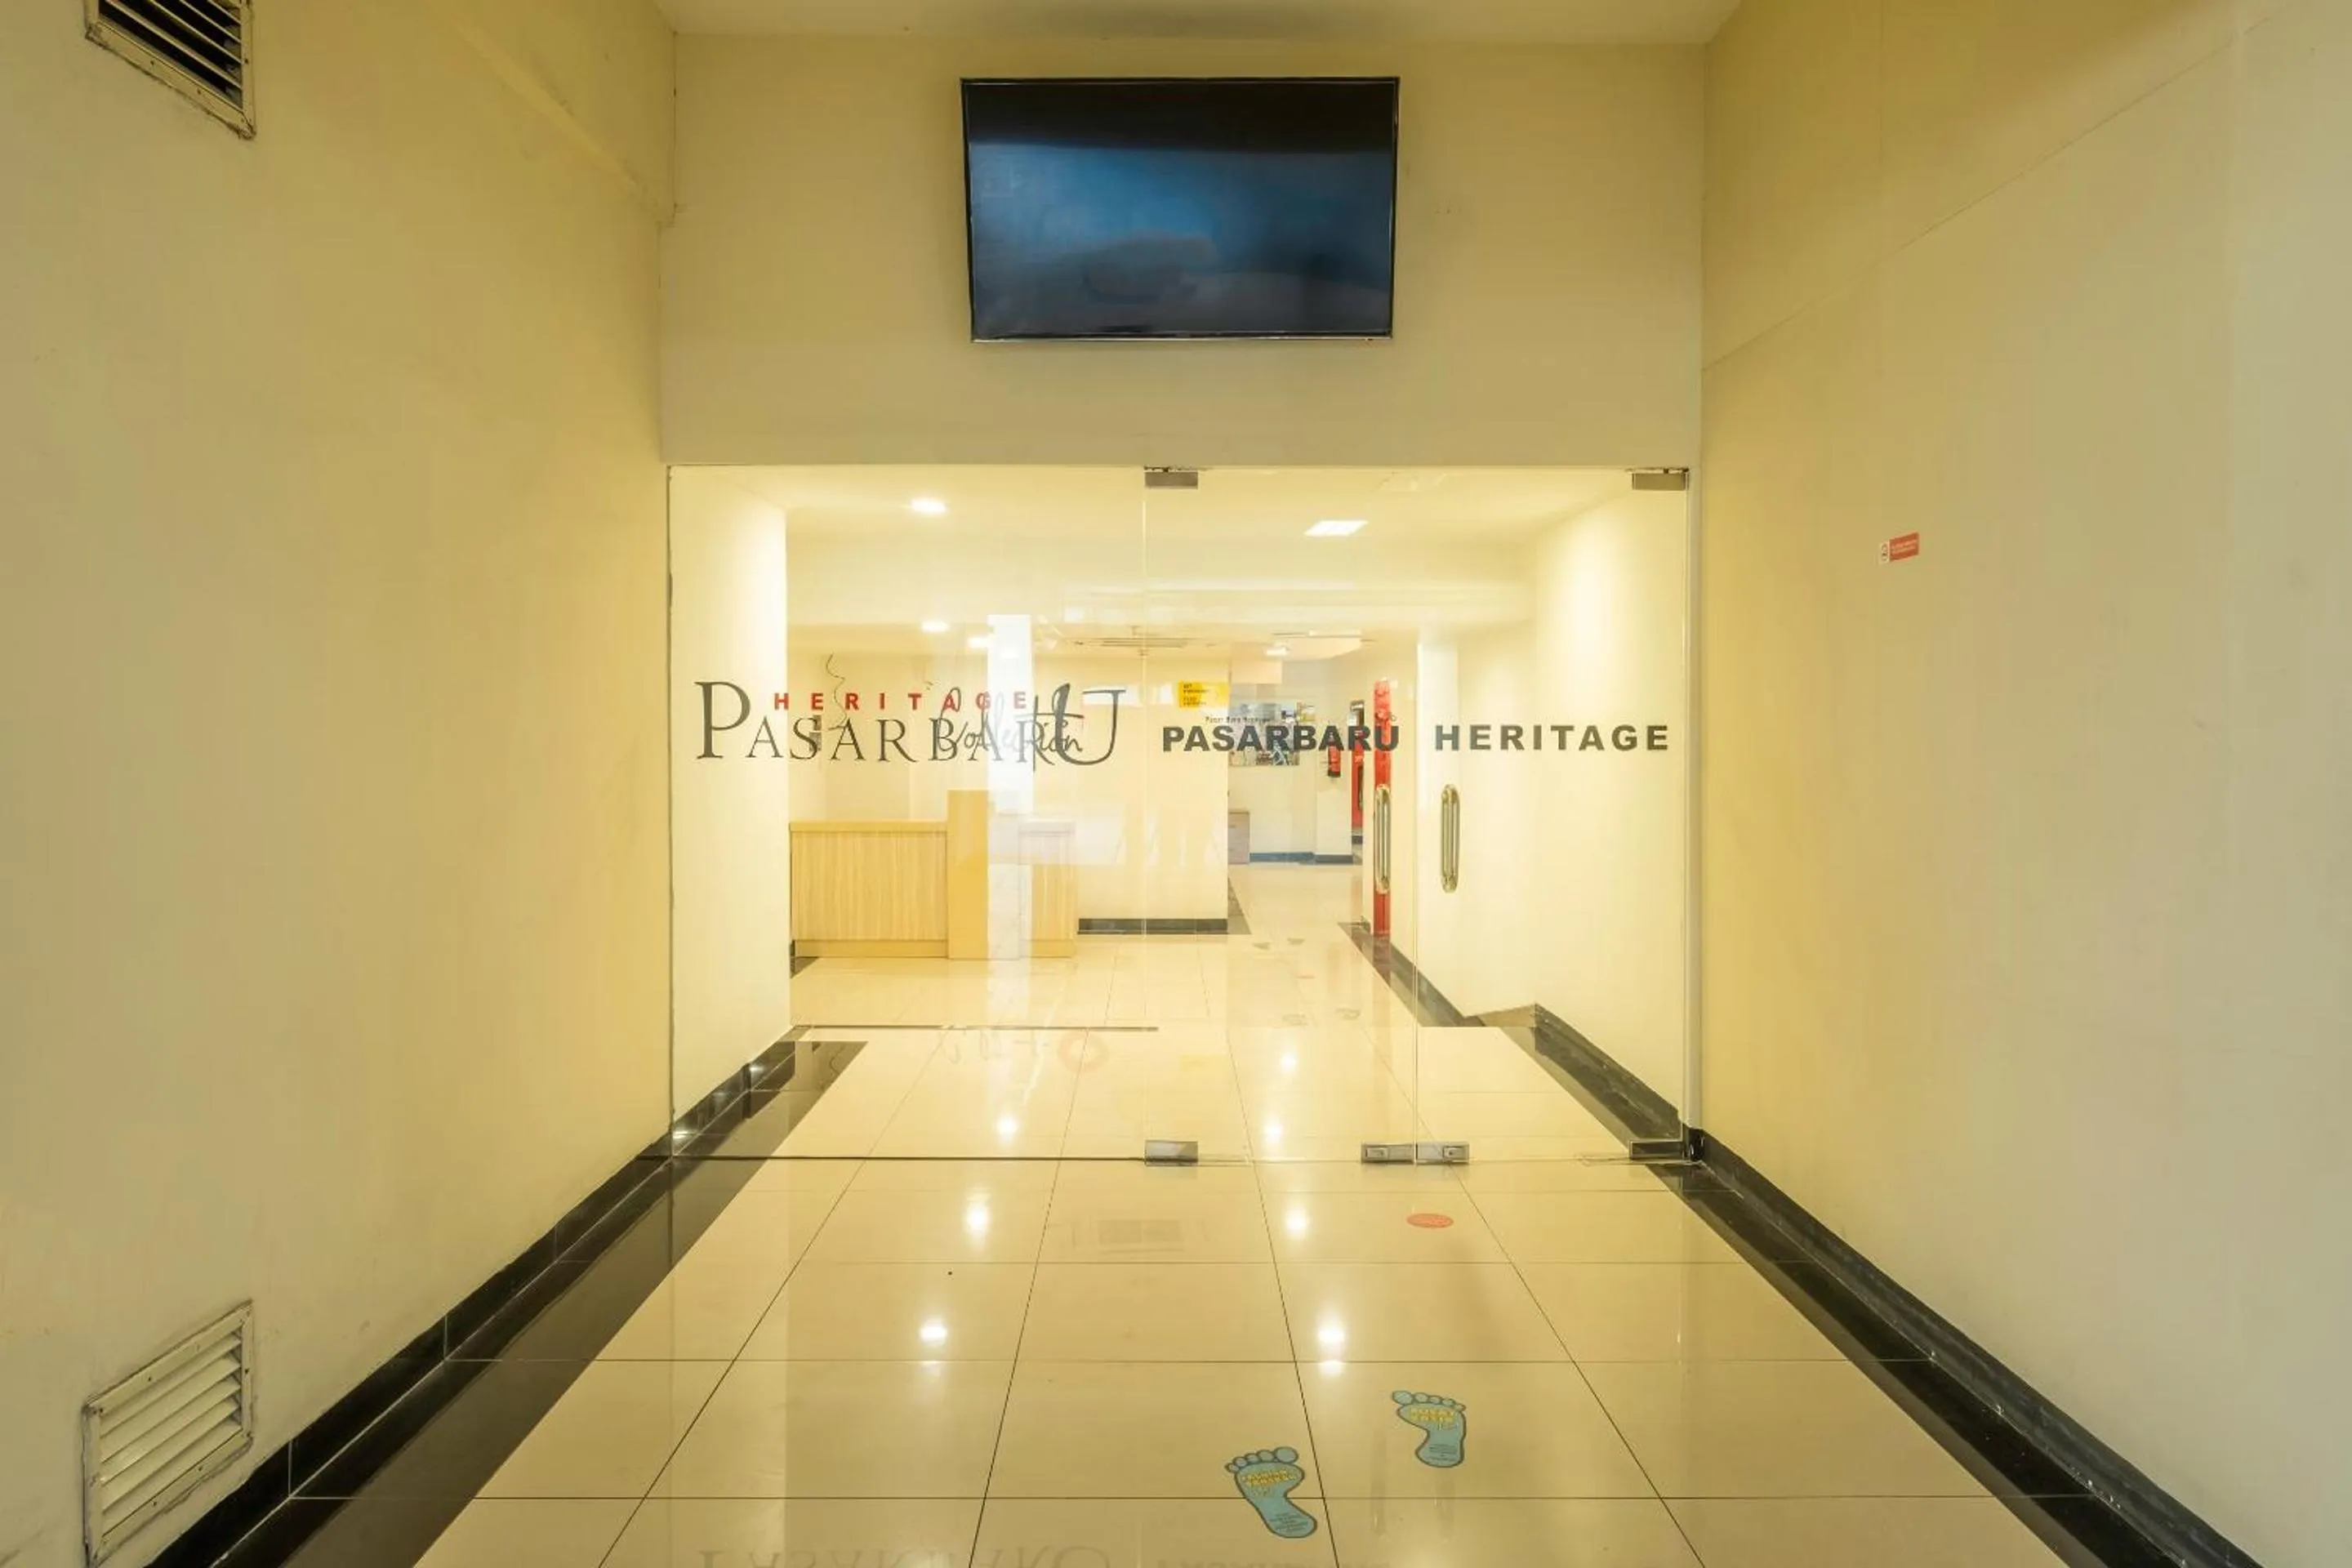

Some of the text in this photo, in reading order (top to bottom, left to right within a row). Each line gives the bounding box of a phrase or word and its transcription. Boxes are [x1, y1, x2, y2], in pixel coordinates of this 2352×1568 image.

[773, 692, 1027, 710] HERITAGE
[693, 680, 1126, 766] PASARBARU
[1162, 724, 1669, 752] PASARBARU HERITAGE
